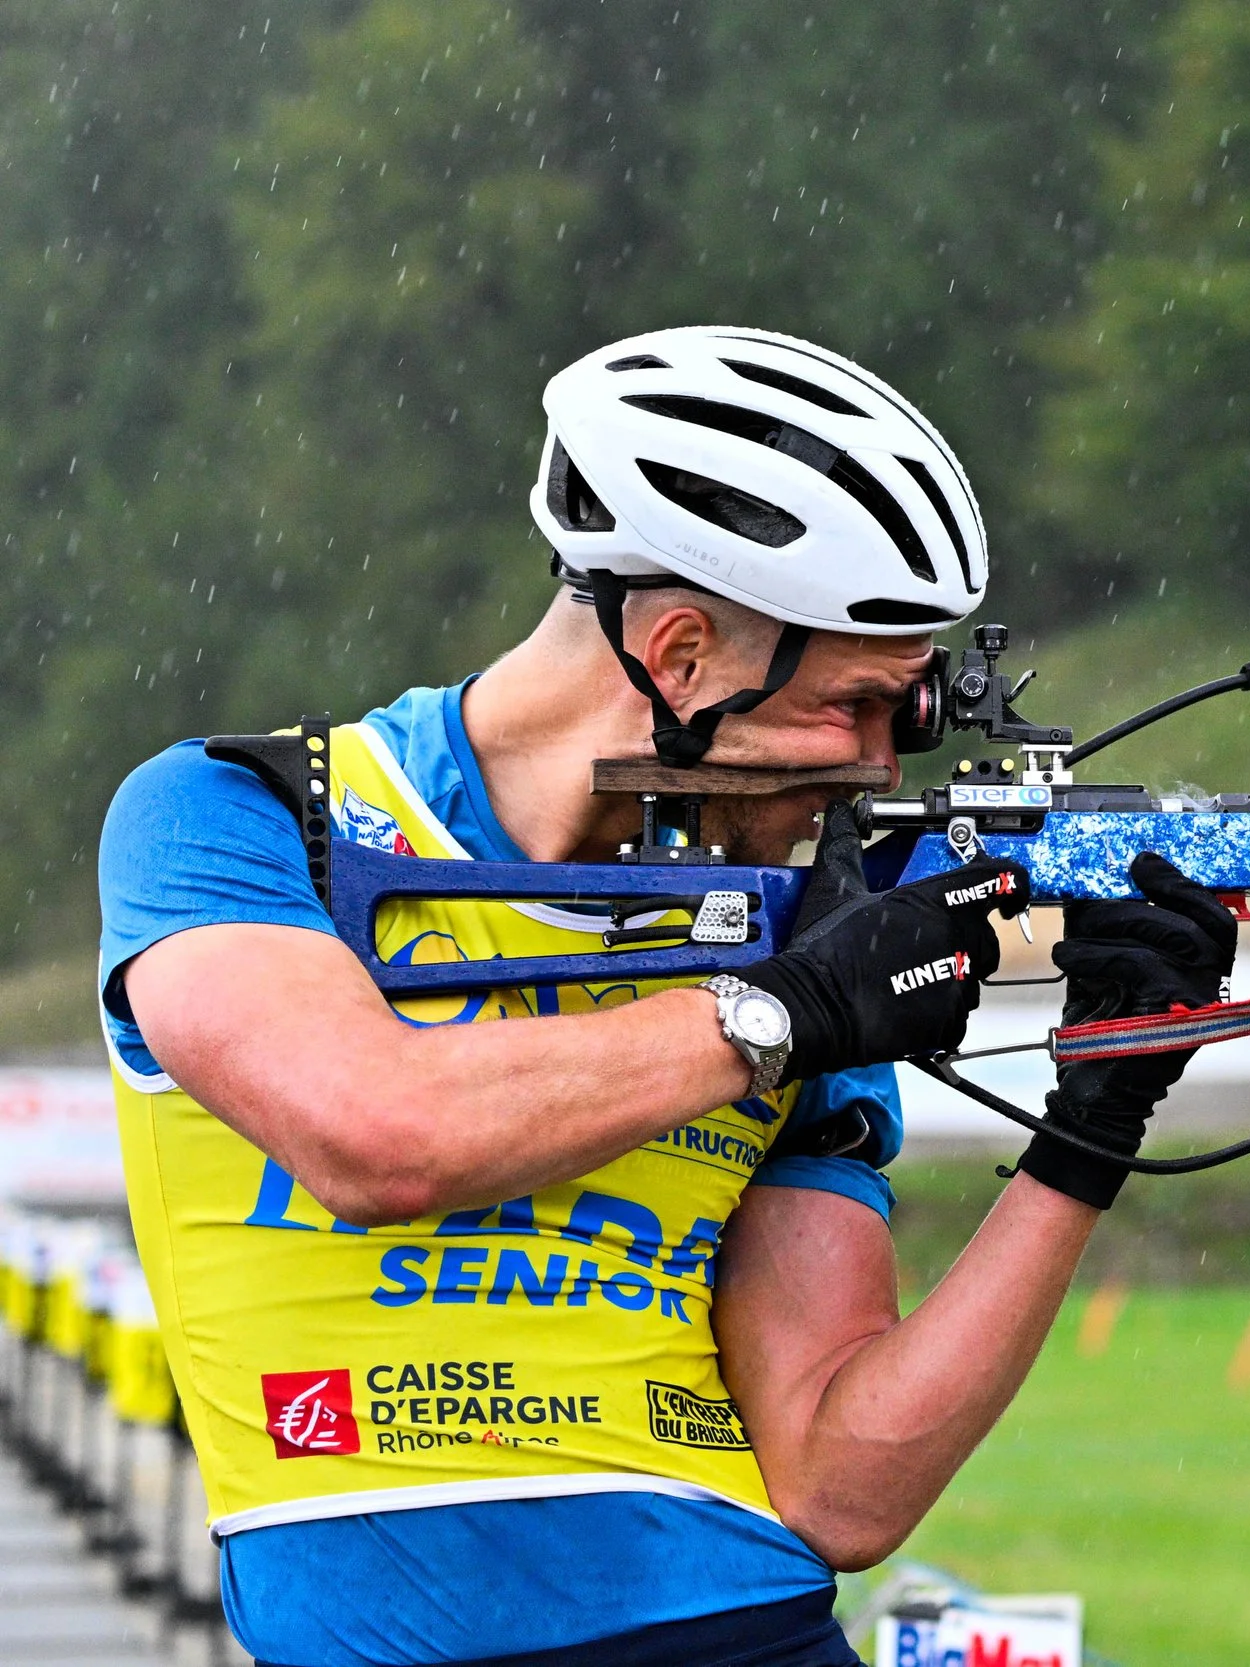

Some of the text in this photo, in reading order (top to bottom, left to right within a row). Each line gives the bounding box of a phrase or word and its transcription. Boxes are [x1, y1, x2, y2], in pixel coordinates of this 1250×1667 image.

[370, 1245, 693, 1326] SENIOR
[366, 1362, 516, 1394] CAISSE
[370, 1395, 603, 1426] D'EPARGNE
[377, 1430, 473, 1455] Rhône
[655, 1418, 682, 1439] DU
